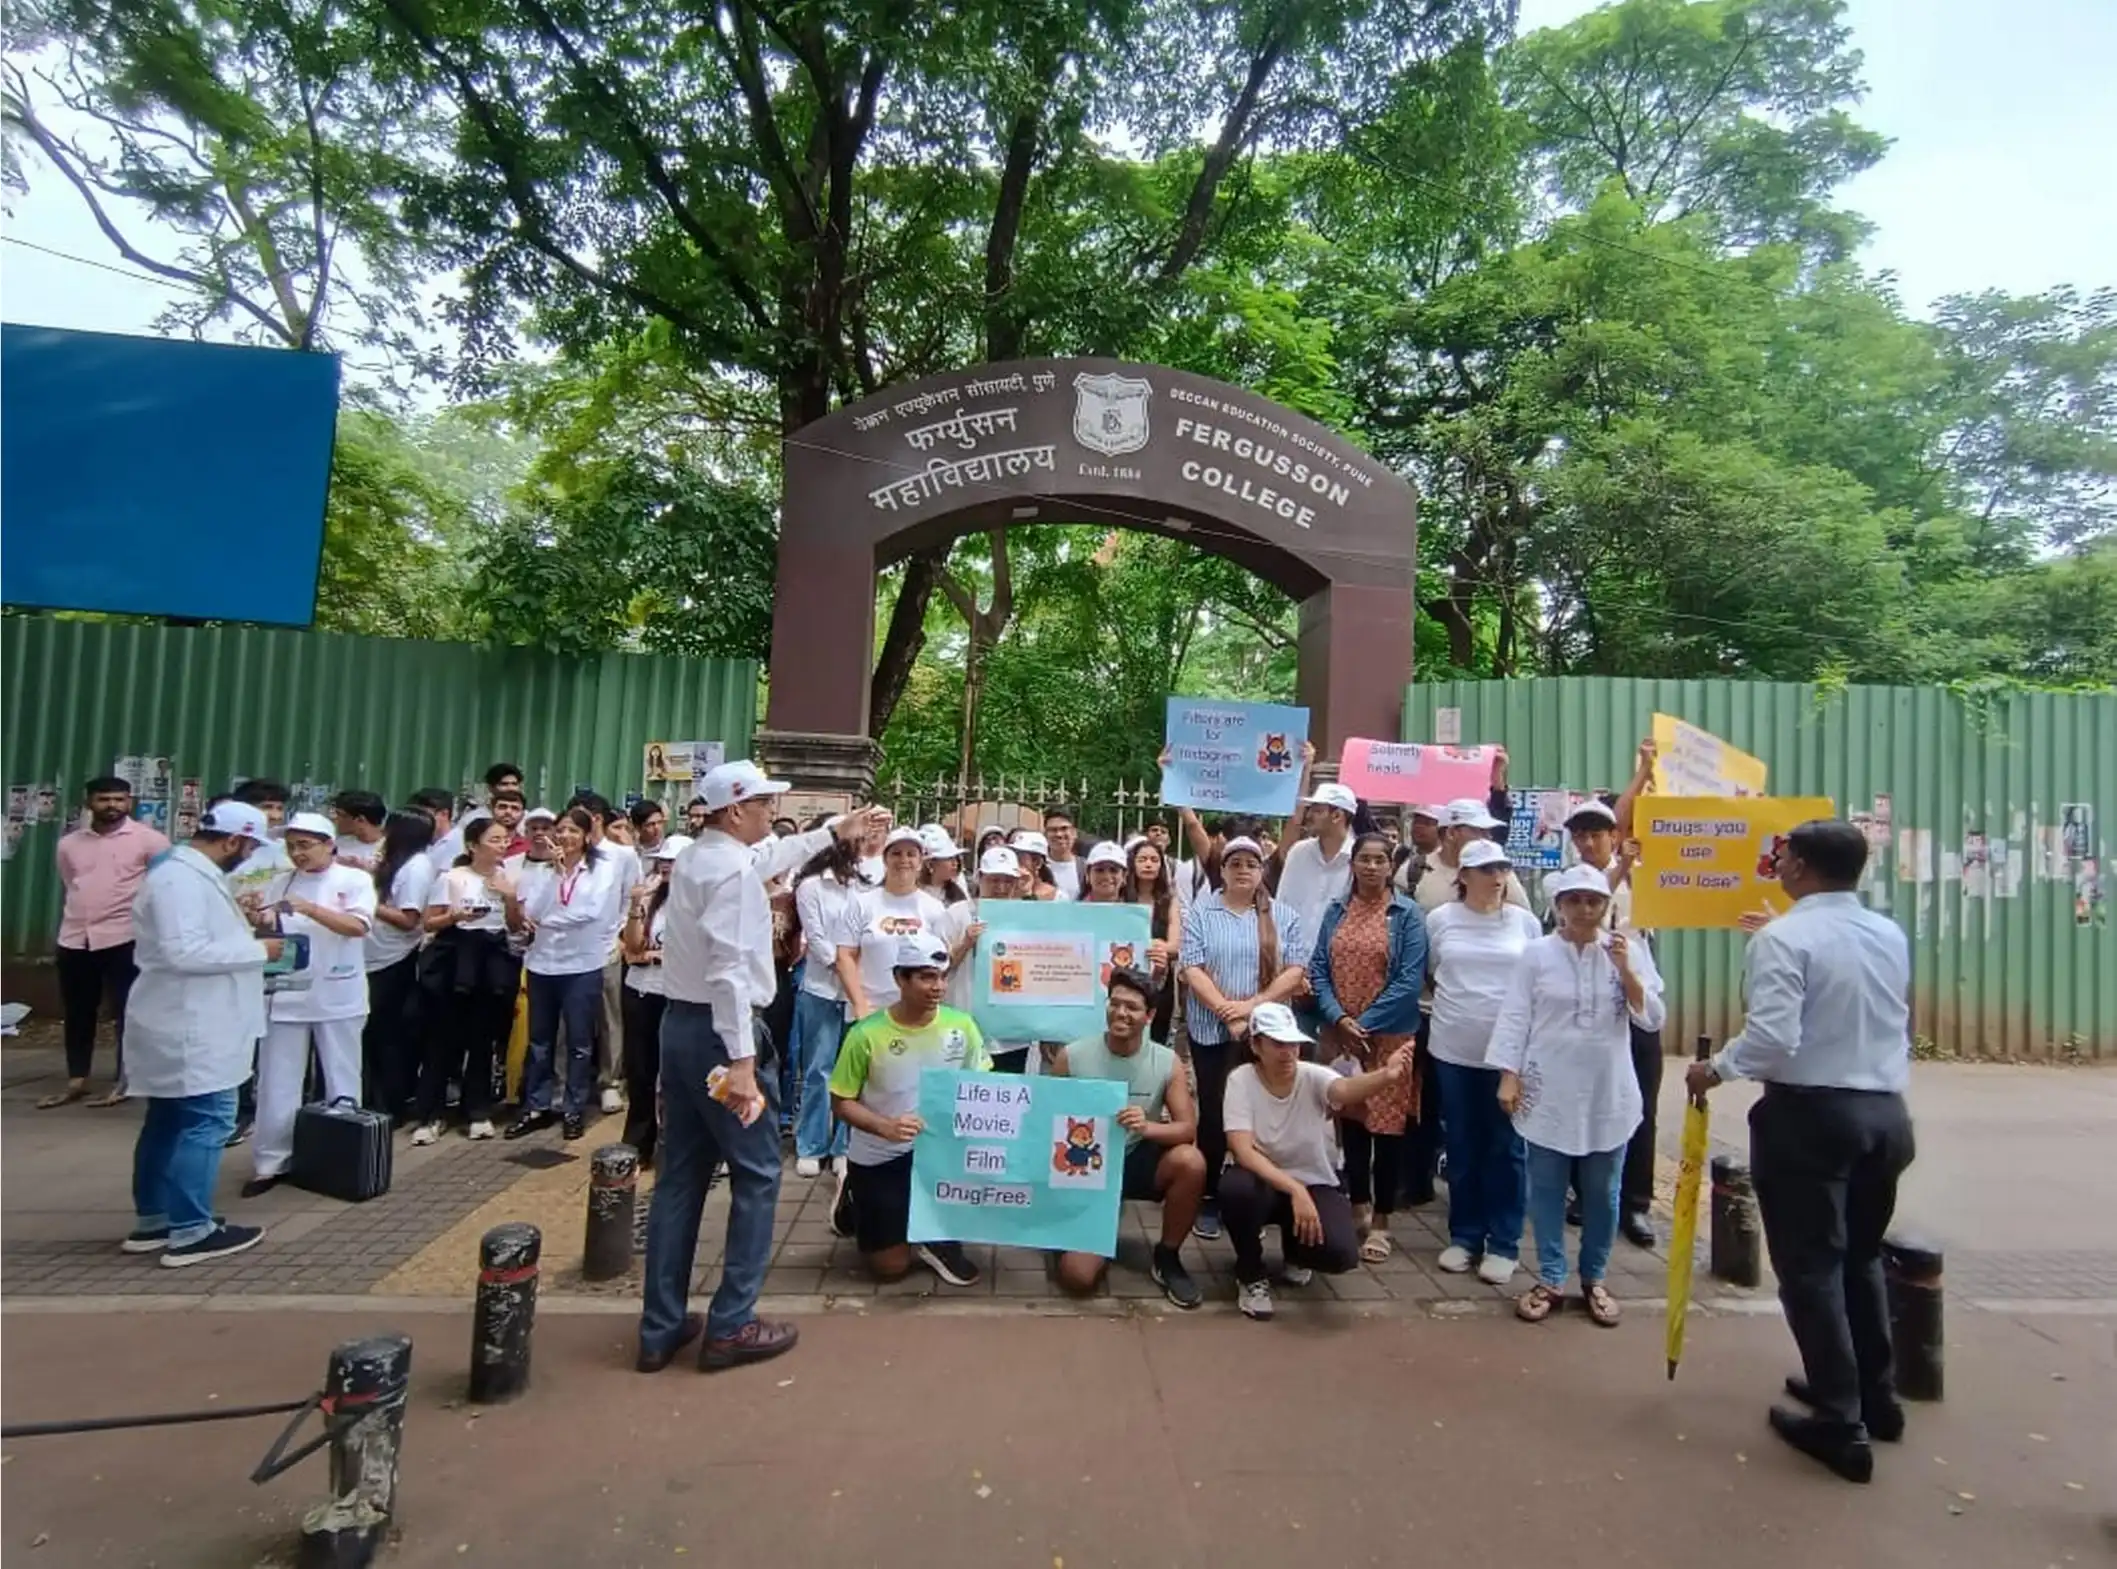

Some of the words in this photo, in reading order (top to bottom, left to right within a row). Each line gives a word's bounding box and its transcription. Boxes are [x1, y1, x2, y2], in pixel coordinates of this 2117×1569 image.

[1170, 387, 1219, 410] DECCAN
[1222, 403, 1288, 438] EDUCATION
[1291, 433, 1341, 469] SOCIETY,
[1175, 417, 1350, 508] FERGUSSON
[868, 444, 1057, 511] महाविद्यालय
[1181, 460, 1316, 529] COLLEGE
[1223, 715, 1246, 727] are
[1206, 728, 1222, 740] for
[1180, 746, 1242, 763] Instagram
[1200, 768, 1222, 779] not
[1714, 821, 1747, 836] you
[1680, 846, 1713, 858] use
[1659, 872, 1691, 888] you
[956, 1083, 991, 1103] Life
[996, 1085, 1011, 1104] is
[1016, 1087, 1031, 1105] A
[966, 1150, 1006, 1169] Film
[936, 1182, 1032, 1206] DrugFree.
